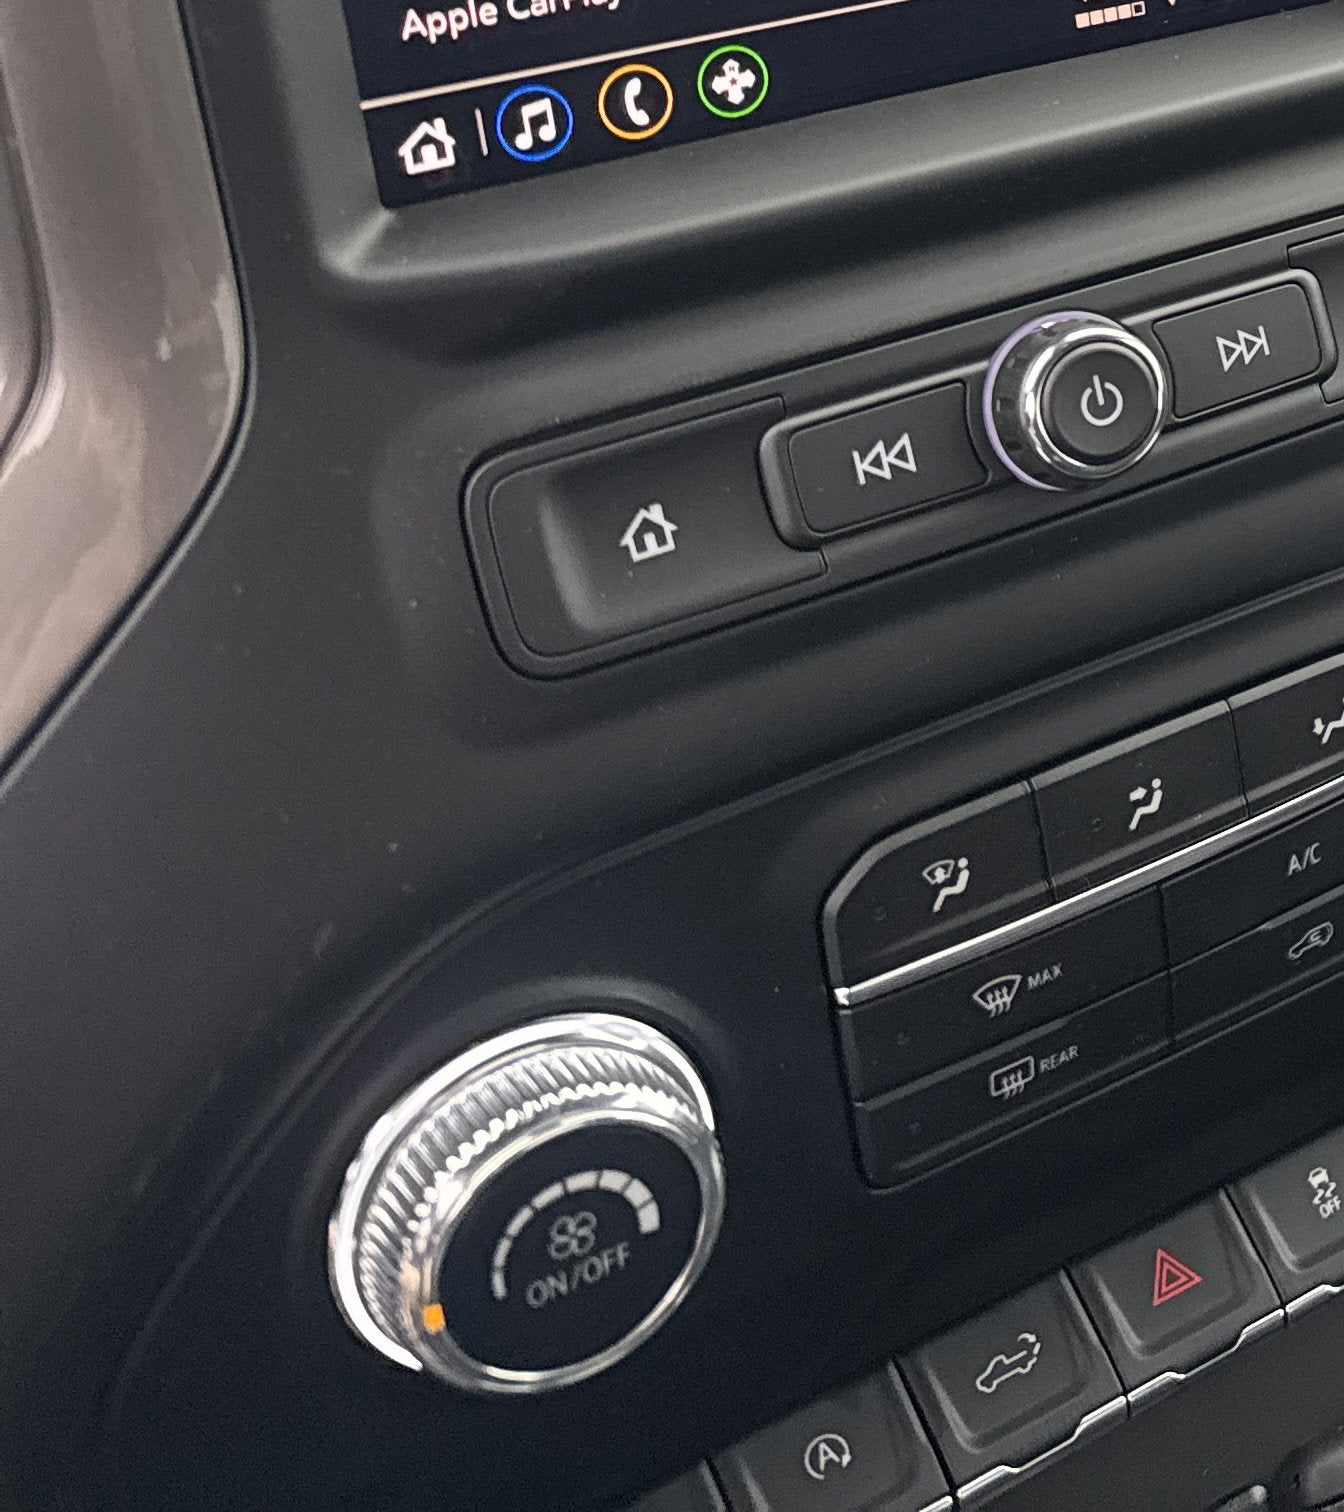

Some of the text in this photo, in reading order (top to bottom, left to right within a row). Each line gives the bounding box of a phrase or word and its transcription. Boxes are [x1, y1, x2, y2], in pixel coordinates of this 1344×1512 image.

[1288, 842, 1322, 876] A/C
[1027, 962, 1063, 990] MAX
[1039, 1045, 1079, 1073] REAR
[1319, 1195, 1341, 1219] OFF
[525, 1242, 632, 1308] ON/OFF
